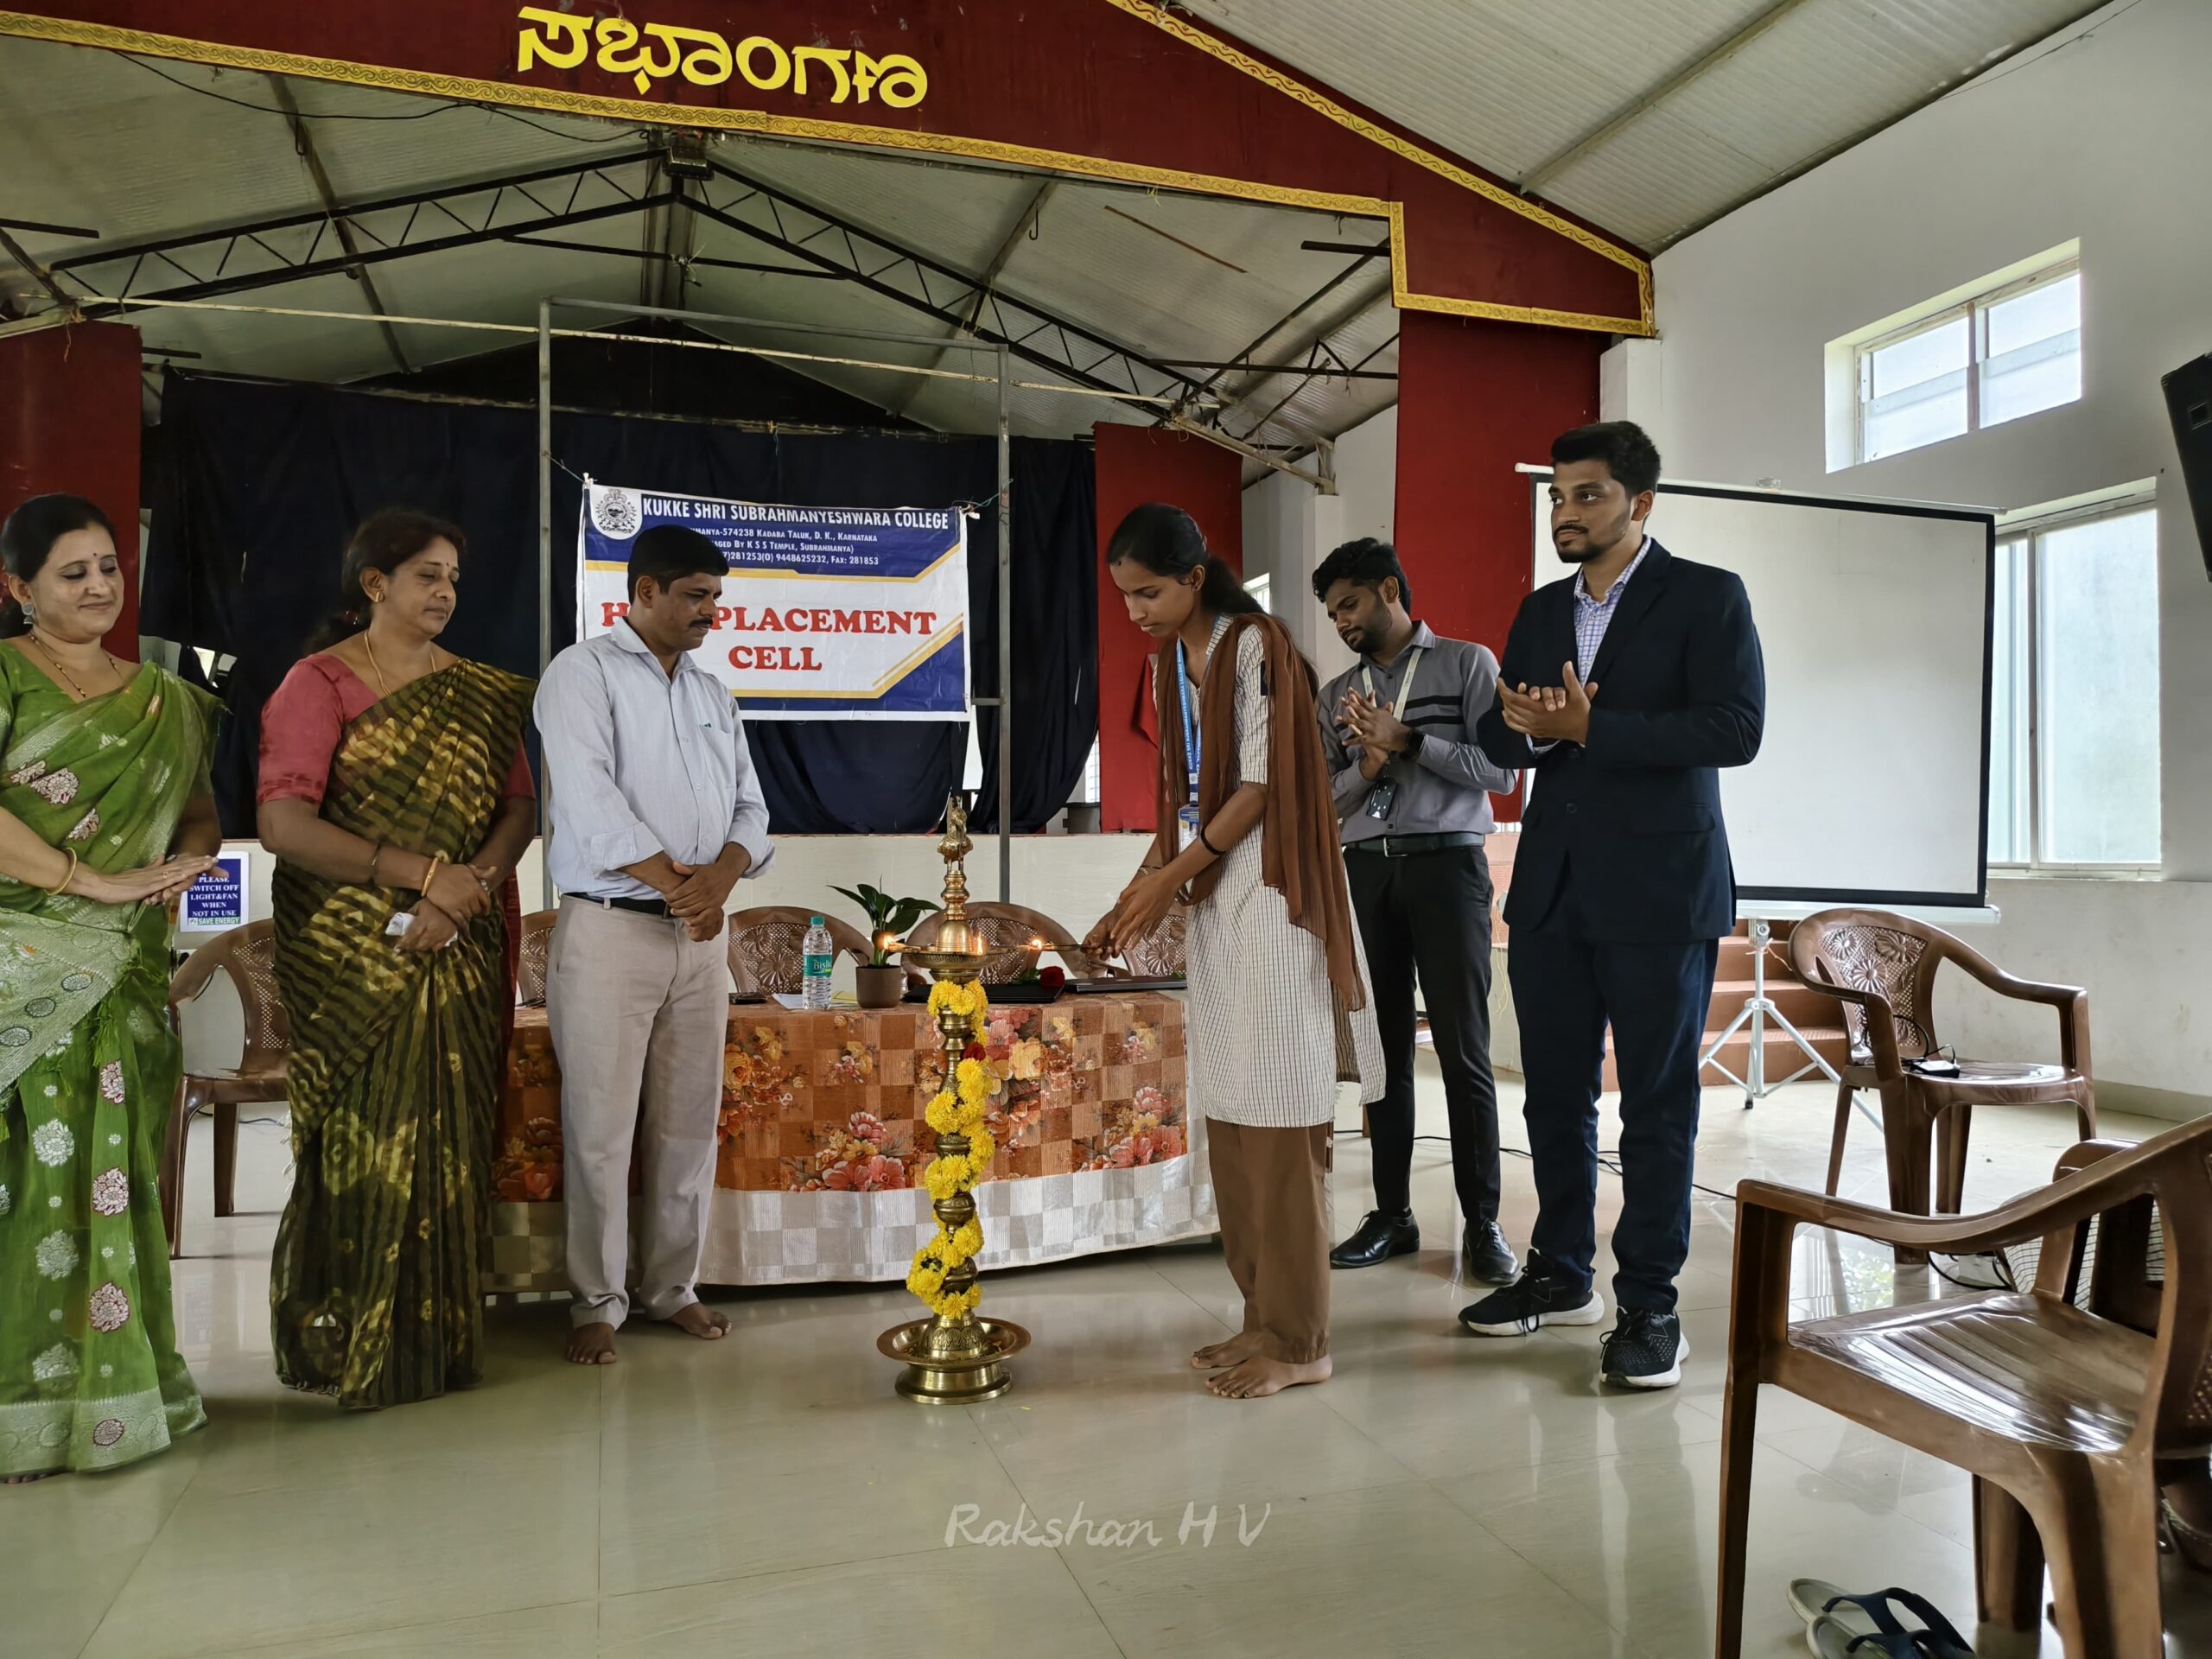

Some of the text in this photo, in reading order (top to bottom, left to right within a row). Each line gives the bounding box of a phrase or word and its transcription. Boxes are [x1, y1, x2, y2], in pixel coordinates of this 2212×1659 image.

[518, 6, 927, 108] ಸಭಾಂಗಣ
[643, 498, 948, 529] KUKKE SHRI SUBRAHMANYESHWARA COLLEGE
[693, 528, 754, 537] MANYA-574238
[747, 540, 753, 549] K
[776, 553, 829, 564] 9448625232,
[849, 556, 879, 565] 281853
[710, 607, 937, 635] PLACEMENT
[728, 645, 823, 671] CELL
